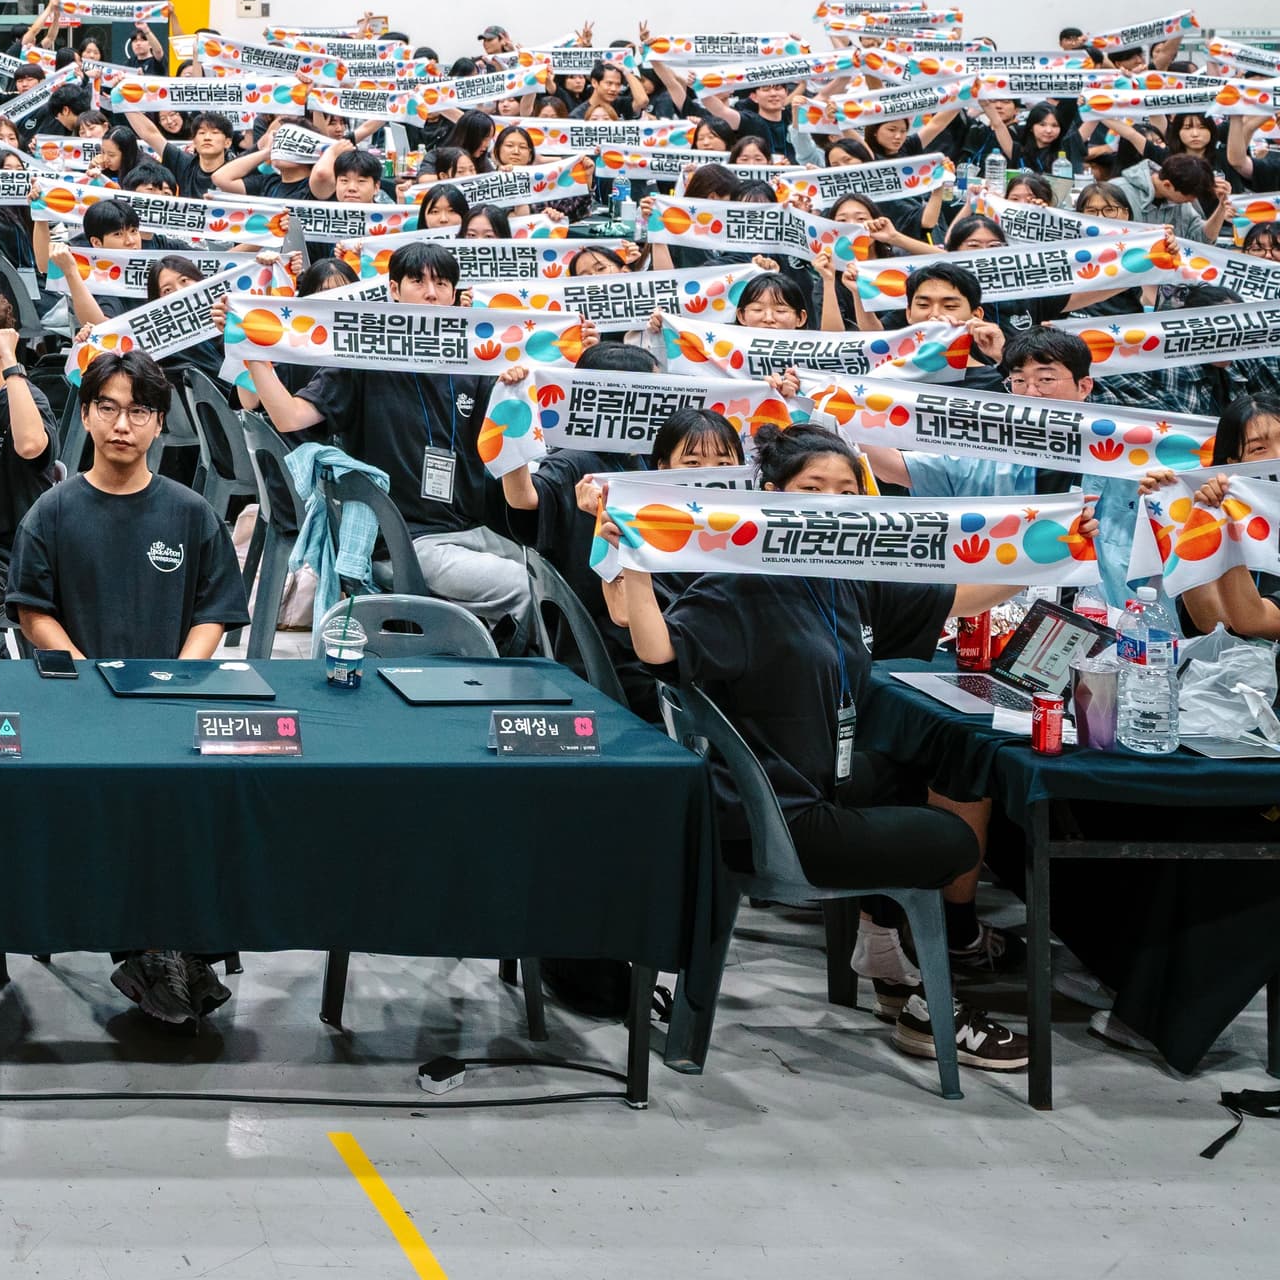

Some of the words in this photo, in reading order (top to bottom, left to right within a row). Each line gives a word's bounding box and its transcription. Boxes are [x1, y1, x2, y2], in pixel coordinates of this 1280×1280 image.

[327, 42, 377, 52] 모험의시작
[695, 36, 758, 45] 모험의시작
[695, 44, 758, 55] 네멋대로해
[241, 53, 299, 72] 네멋대로해
[242, 46, 301, 64] 모험의시작
[552, 51, 603, 60] 모험의시작
[966, 56, 1036, 67] 모험의시작
[455, 75, 505, 90] 모험의시작
[457, 83, 505, 99] 네멋대로해
[1009, 81, 1084, 91] 네멋대로해
[170, 90, 242, 103] 네멋대로해
[341, 89, 389, 101] 모험의시작
[340, 98, 388, 113] 네멋대로해
[883, 95, 938, 115] 네멋대로해
[570, 126, 640, 137] 모험의시작
[463, 171, 530, 193] 모험의시작
[817, 167, 899, 189] 모험의시작
[726, 209, 806, 233] 모험의시작
[1000, 208, 1083, 233] 모험의시작
[726, 223, 810, 255] 네멋대로해
[459, 262, 539, 278] 멋대로해
[980, 267, 1073, 290] 멋대로해
[564, 279, 678, 303] 모험의시작
[128, 279, 232, 332] 모험의시작
[333, 311, 468, 337] 모험의시작
[333, 331, 468, 359] 네멋대로해
[750, 337, 866, 359] 모험의시작
[915, 393, 1085, 433] 모험의시작
[915, 437, 941, 445] LIKELION
[972, 444, 1008, 454] HACKATHON
[916, 417, 1082, 457] 네멋대로해
[761, 508, 950, 533] 모험의시작
[760, 527, 947, 561] 네멋대로해
